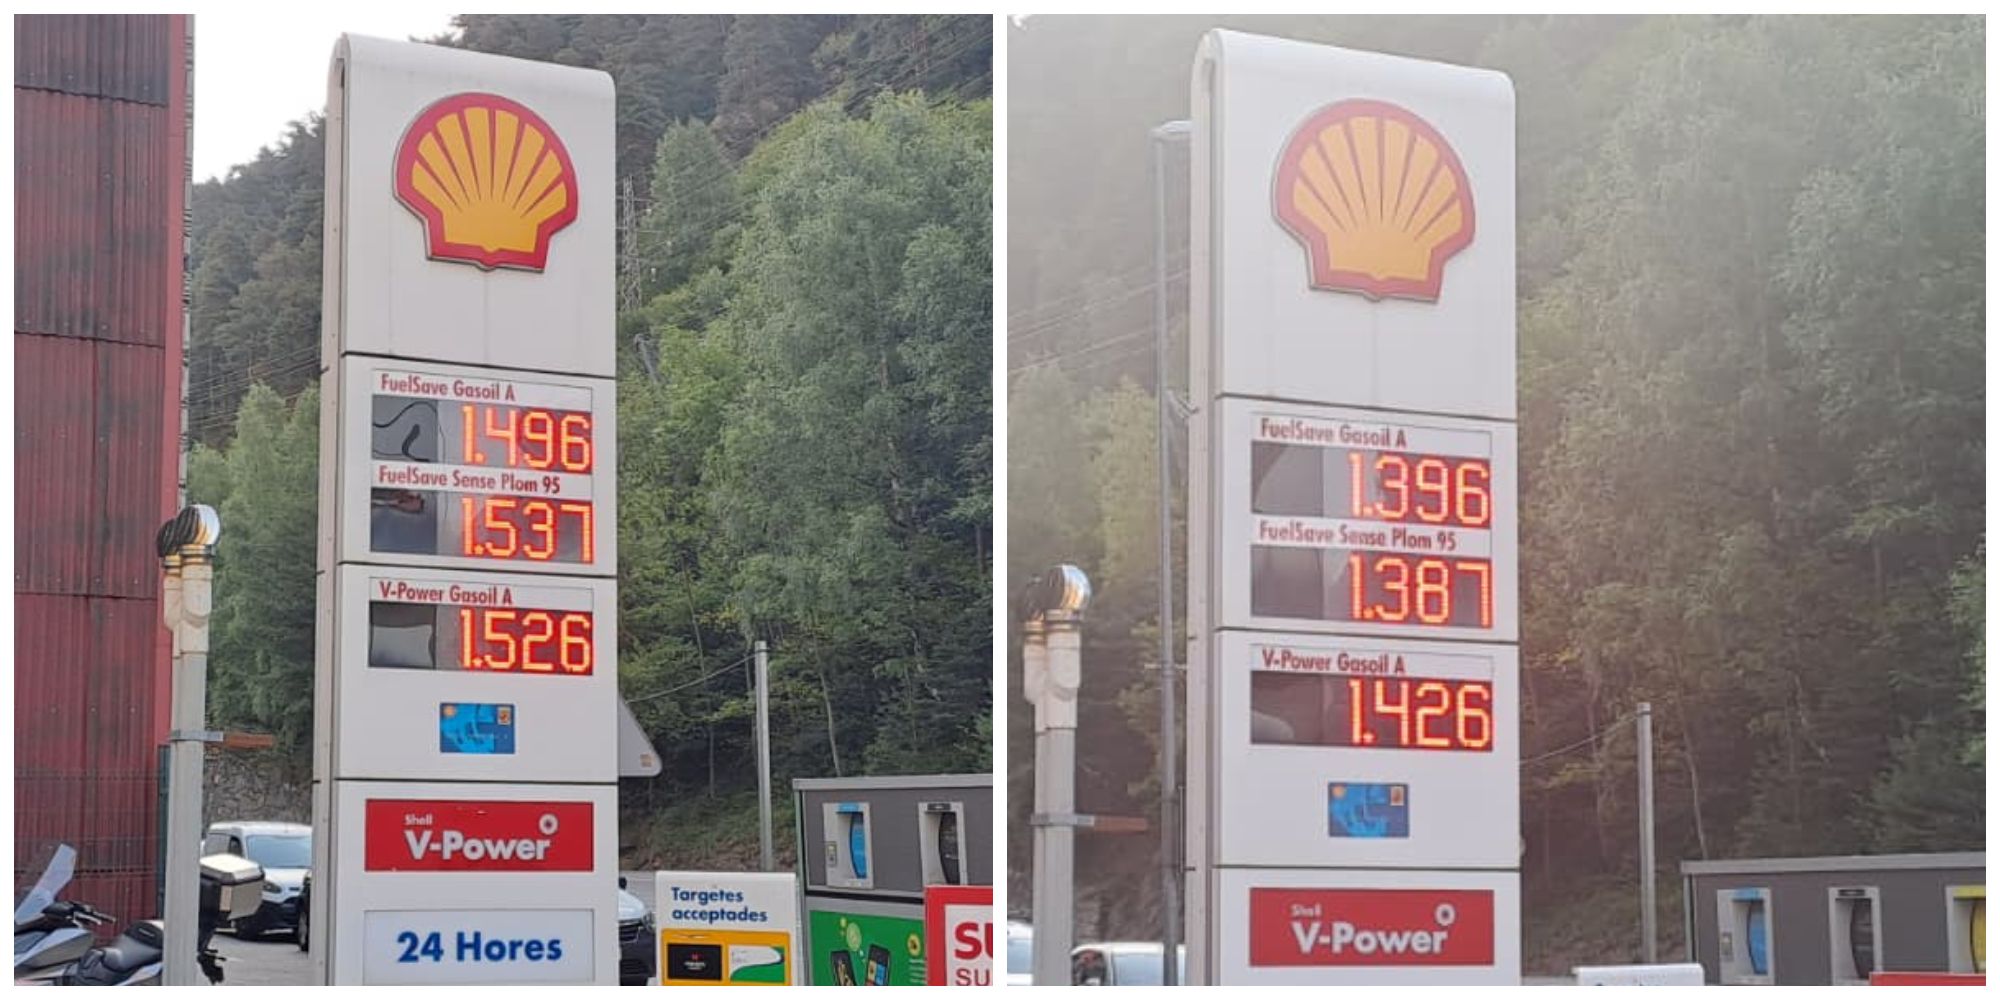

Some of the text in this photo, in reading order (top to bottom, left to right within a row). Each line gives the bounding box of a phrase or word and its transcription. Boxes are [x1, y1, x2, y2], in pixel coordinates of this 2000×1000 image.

[380, 373, 516, 402] FuelSave Gasoil A
[461, 404, 592, 472] 1.496
[1261, 417, 1407, 449] FuelSave Gasoil A
[379, 465, 561, 494] FuelSave Sense Plom 95
[1349, 452, 1490, 525] 1.396
[461, 496, 593, 563] 1.537
[1260, 520, 1458, 551] FuelSave Sense Plom 95
[379, 580, 514, 605] V-Power Gasoil A
[1349, 553, 1493, 629] 1.387
[460, 608, 592, 673] 1.526
[1262, 649, 1406, 674] V-Power Gasoil A
[1349, 679, 1491, 748] 1.426
[404, 813, 433, 826] Shell
[403, 829, 551, 861] V-Power
[671, 886, 744, 906] Targetes
[672, 906, 768, 925] acceptades
[397, 930, 563, 963] 24 Hores
[1291, 920, 1448, 954] V-Power
